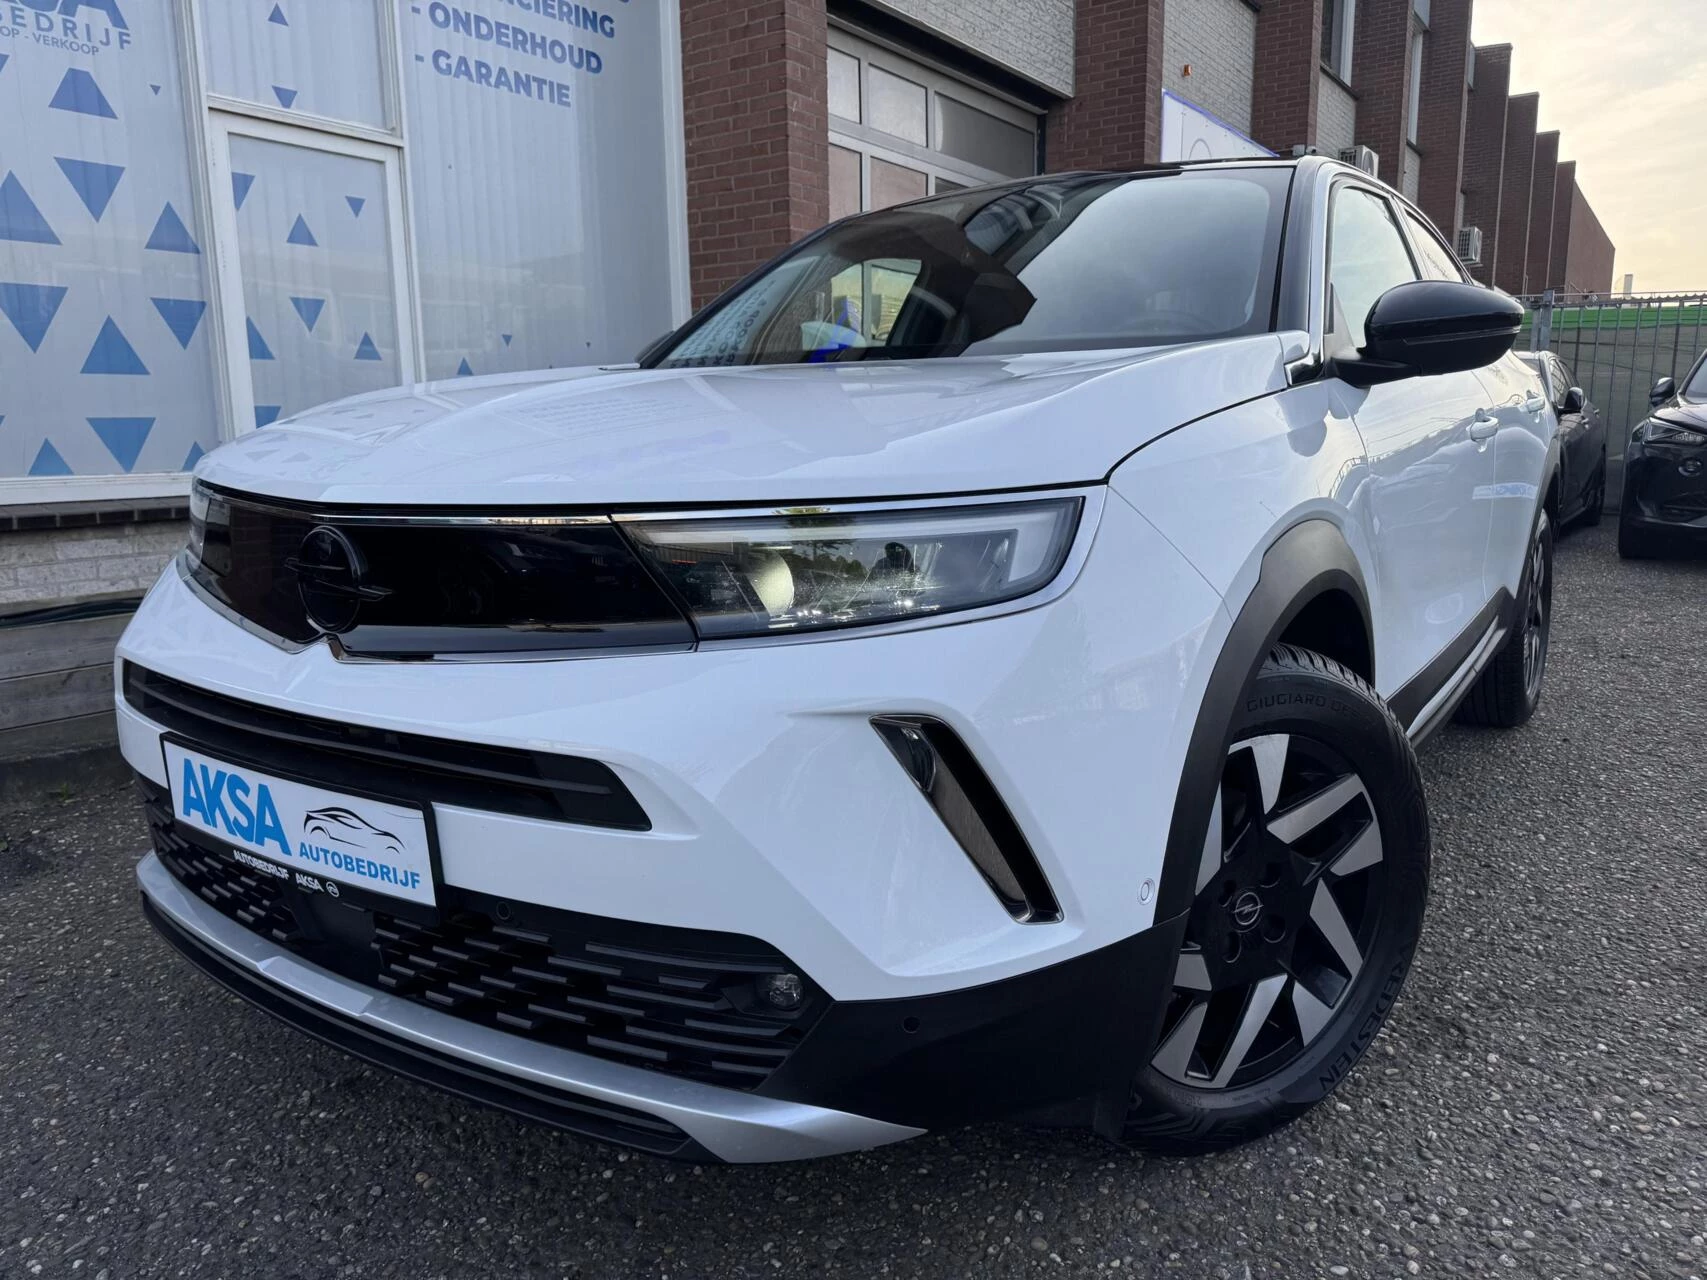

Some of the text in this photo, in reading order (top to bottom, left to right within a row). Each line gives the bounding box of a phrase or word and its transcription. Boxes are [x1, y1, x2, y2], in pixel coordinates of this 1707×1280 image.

[0, 5, 131, 49] EDRIJF
[428, 2, 602, 74] ONDERHOUD
[501, 0, 615, 38] IERING
[32, 32, 99, 55] VERKOOP
[432, 49, 571, 108] GARANTIE
[1247, 692, 1326, 712] GIUGIARO
[183, 758, 292, 857] AKSA
[233, 849, 325, 893] AUTOBEDRIJF AKSA
[299, 841, 420, 890] AUTOBEDRIJF
